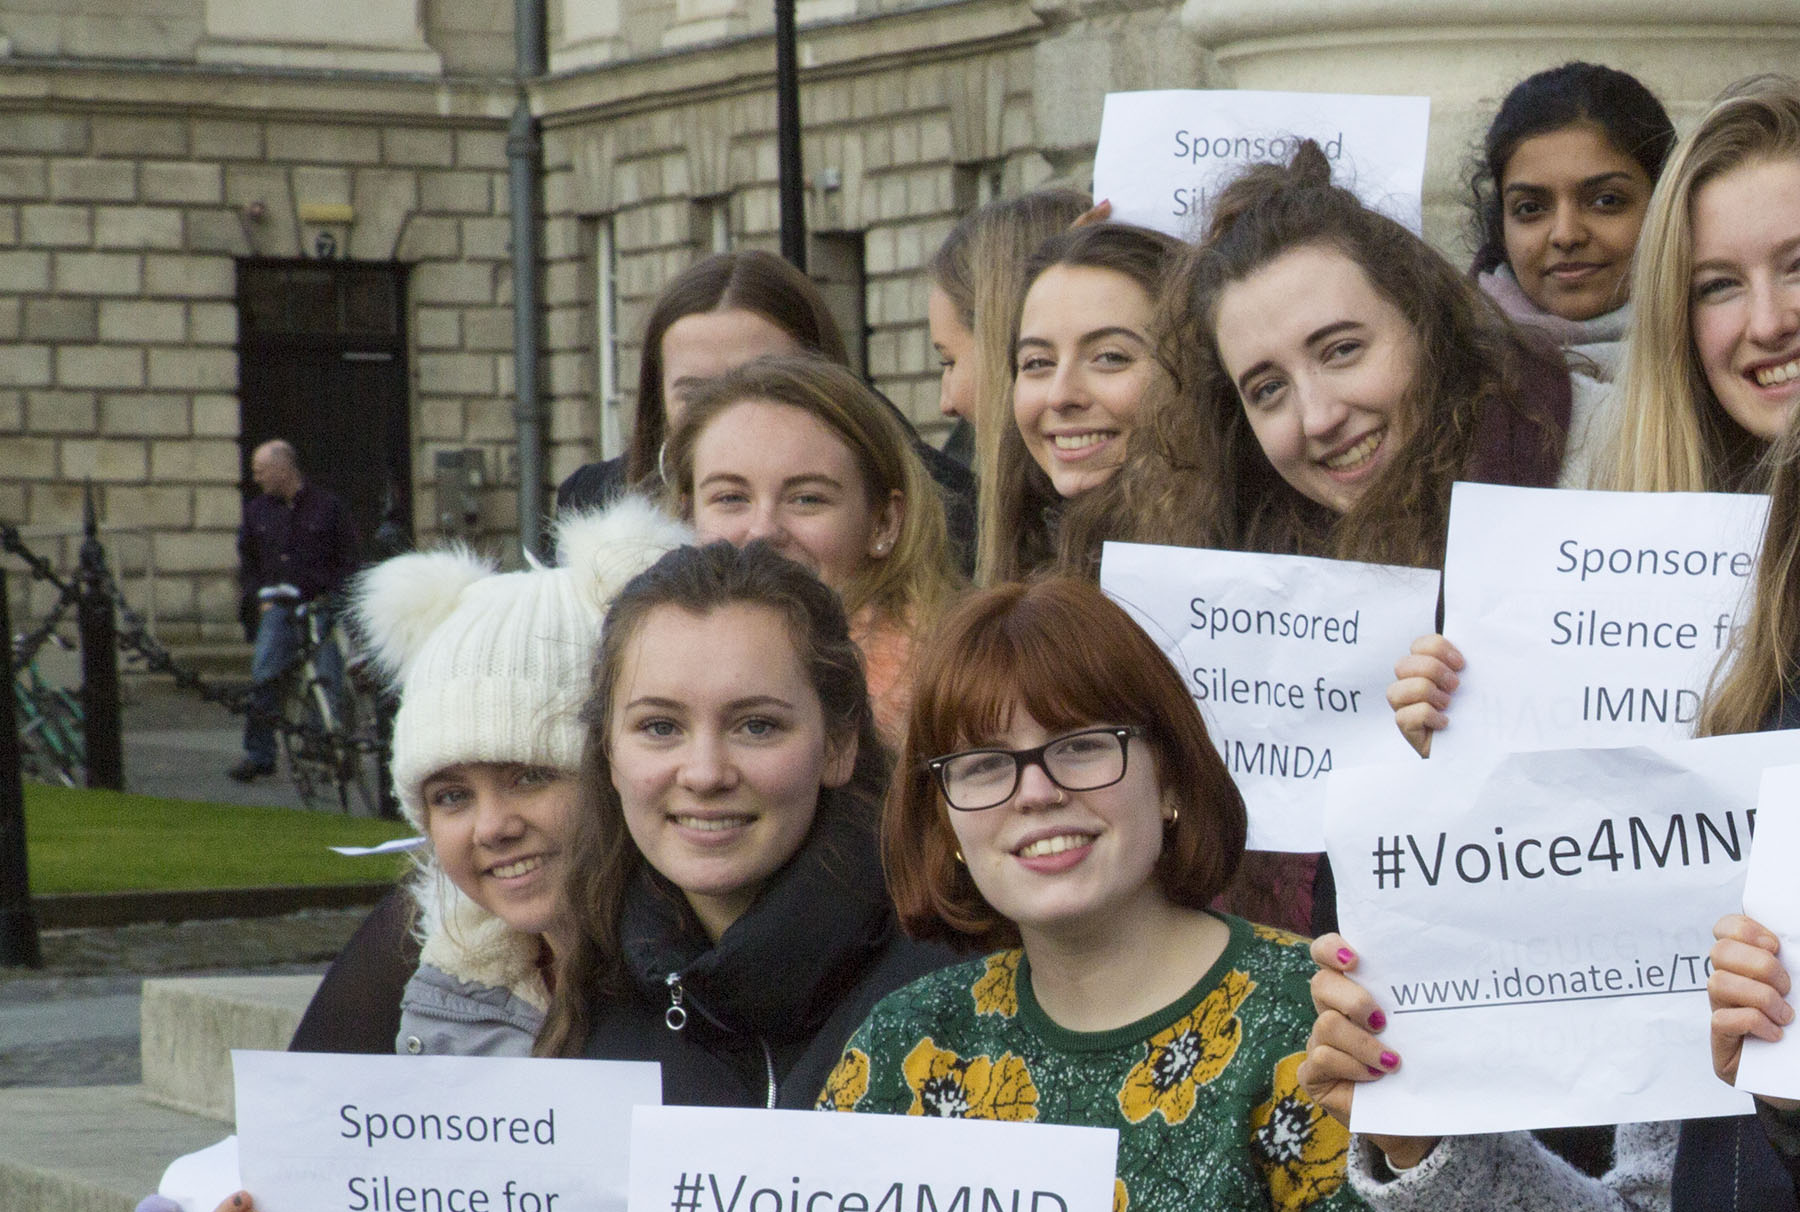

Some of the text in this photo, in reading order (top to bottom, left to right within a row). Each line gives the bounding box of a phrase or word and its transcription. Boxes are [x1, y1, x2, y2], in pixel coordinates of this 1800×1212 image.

[1173, 129, 1343, 164] Sponsod
[1556, 540, 1752, 582] Sponsore
[1190, 597, 1360, 645] Sponsored
[1550, 610, 1698, 649] Silence
[1192, 667, 1362, 713] Silence for
[1582, 686, 1700, 723] IMND
[1224, 739, 1333, 780] IMNDA
[1391, 953, 1711, 1010] www.idonate.ie/T
[339, 1104, 556, 1147] Sponsored
